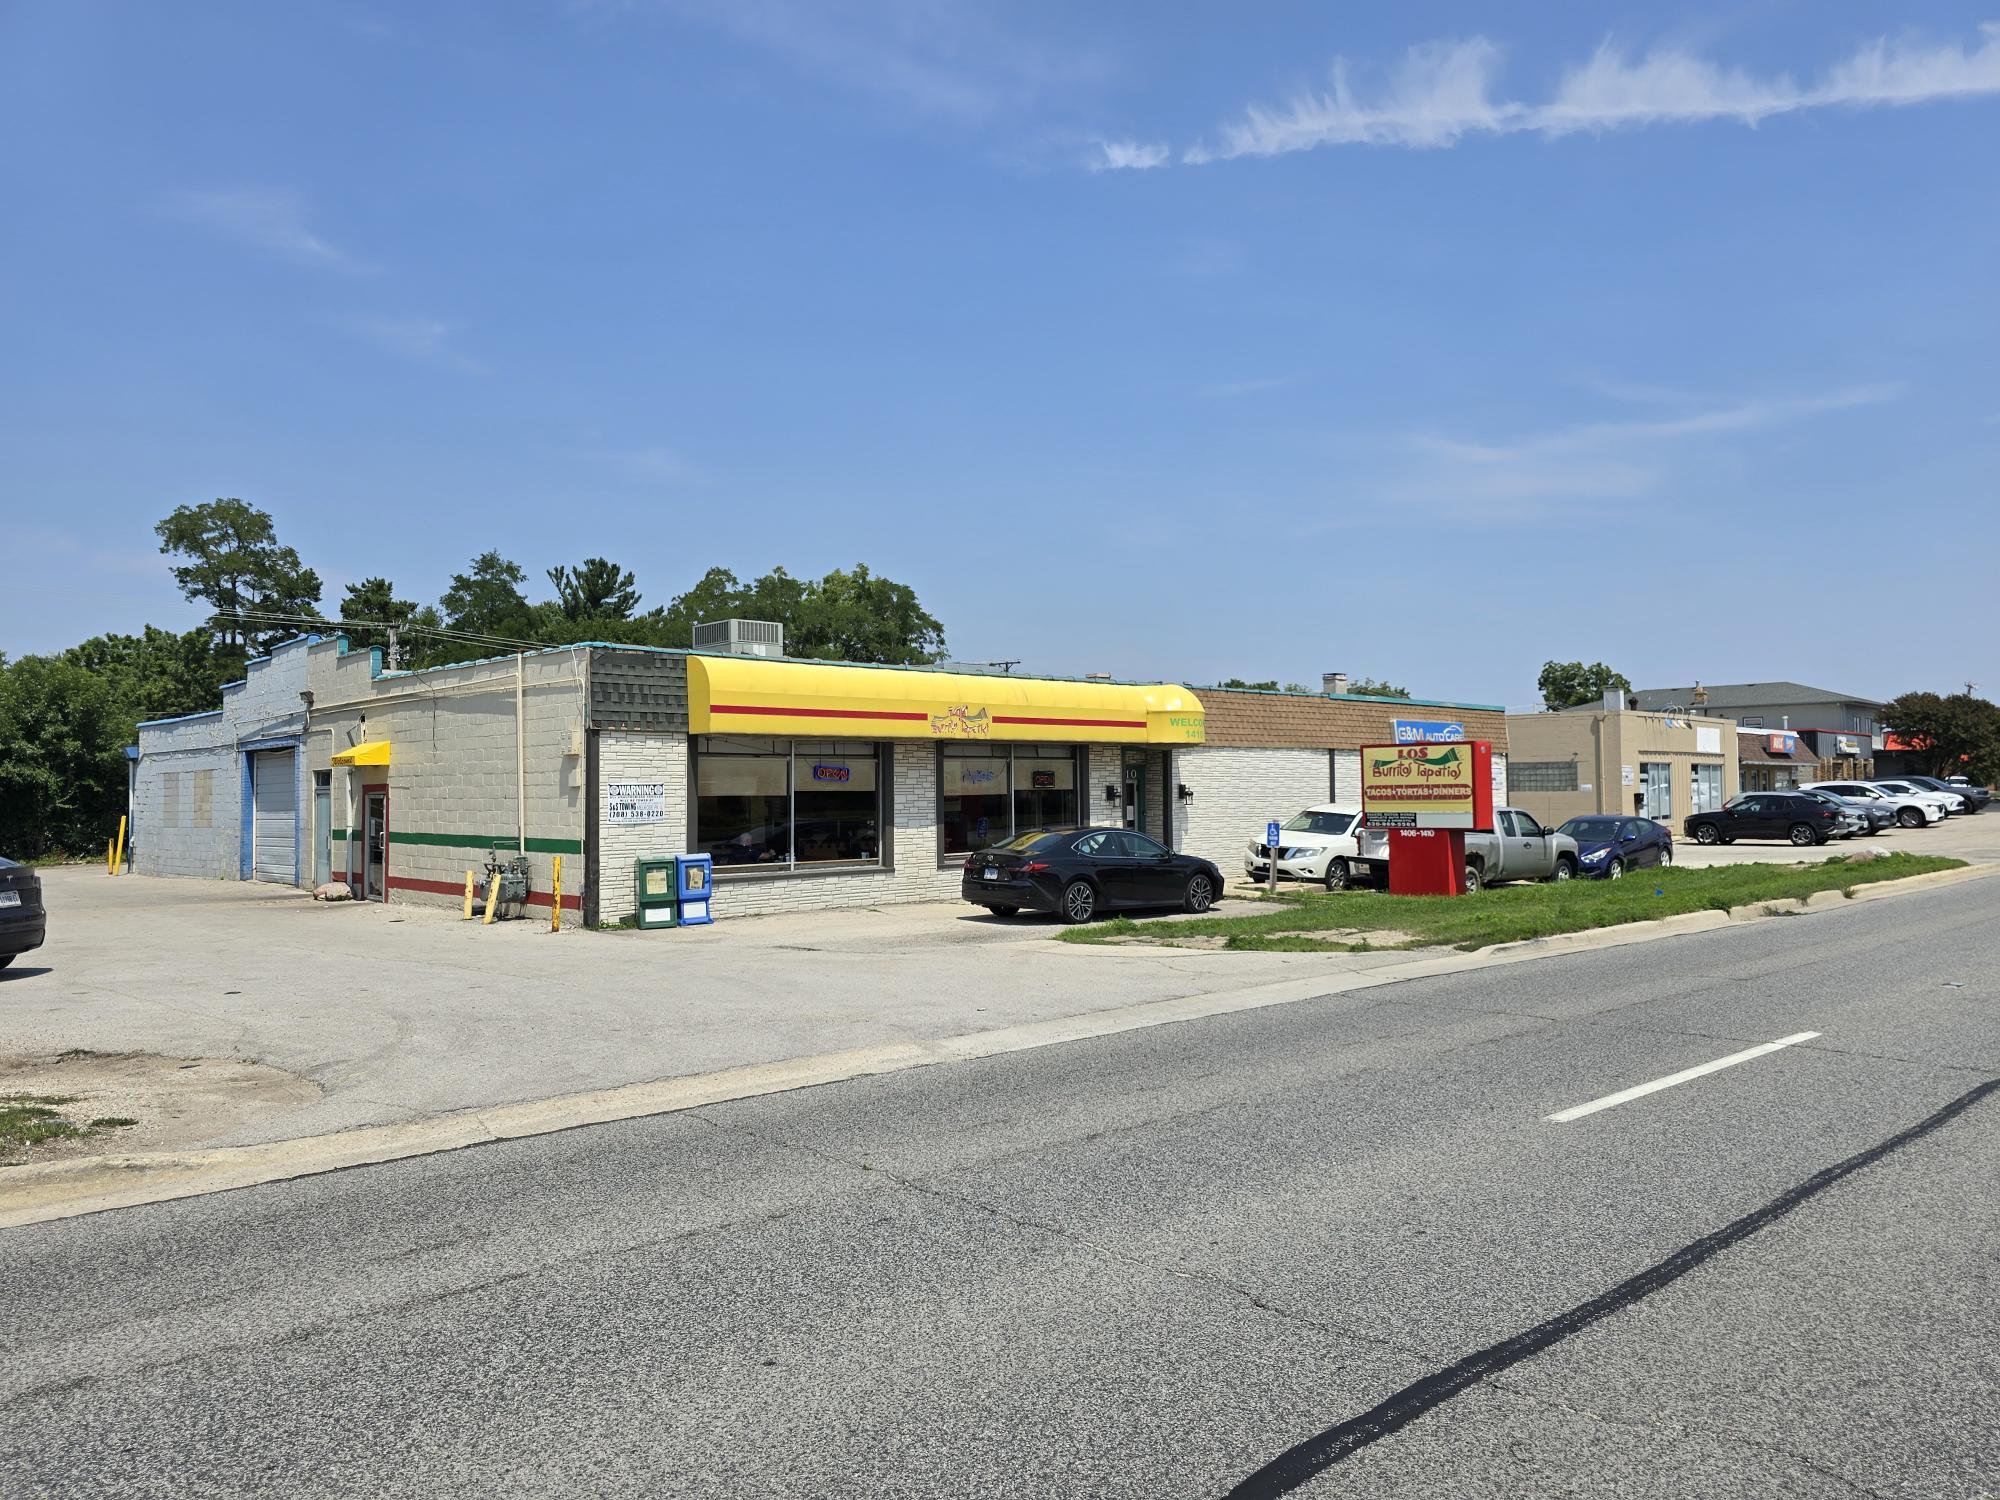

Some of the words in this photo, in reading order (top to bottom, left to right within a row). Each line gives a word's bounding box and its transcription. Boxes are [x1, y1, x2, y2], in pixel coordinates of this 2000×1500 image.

[1398, 726, 1424, 741] G&M
[1425, 732, 1444, 741] AUTO
[1445, 733, 1464, 742] CARE
[1397, 747, 1428, 759] LOS
[817, 767, 849, 780] OPEN
[1372, 762, 1412, 777] Burritos
[1414, 761, 1463, 782] Tapatios
[1035, 774, 1054, 785] OPEN
[619, 785, 655, 795] WARNING
[1366, 788, 1393, 796] TACOS
[1396, 788, 1430, 796] TORTAS
[1433, 787, 1472, 796] DINNERS
[619, 802, 637, 810] TOWING
